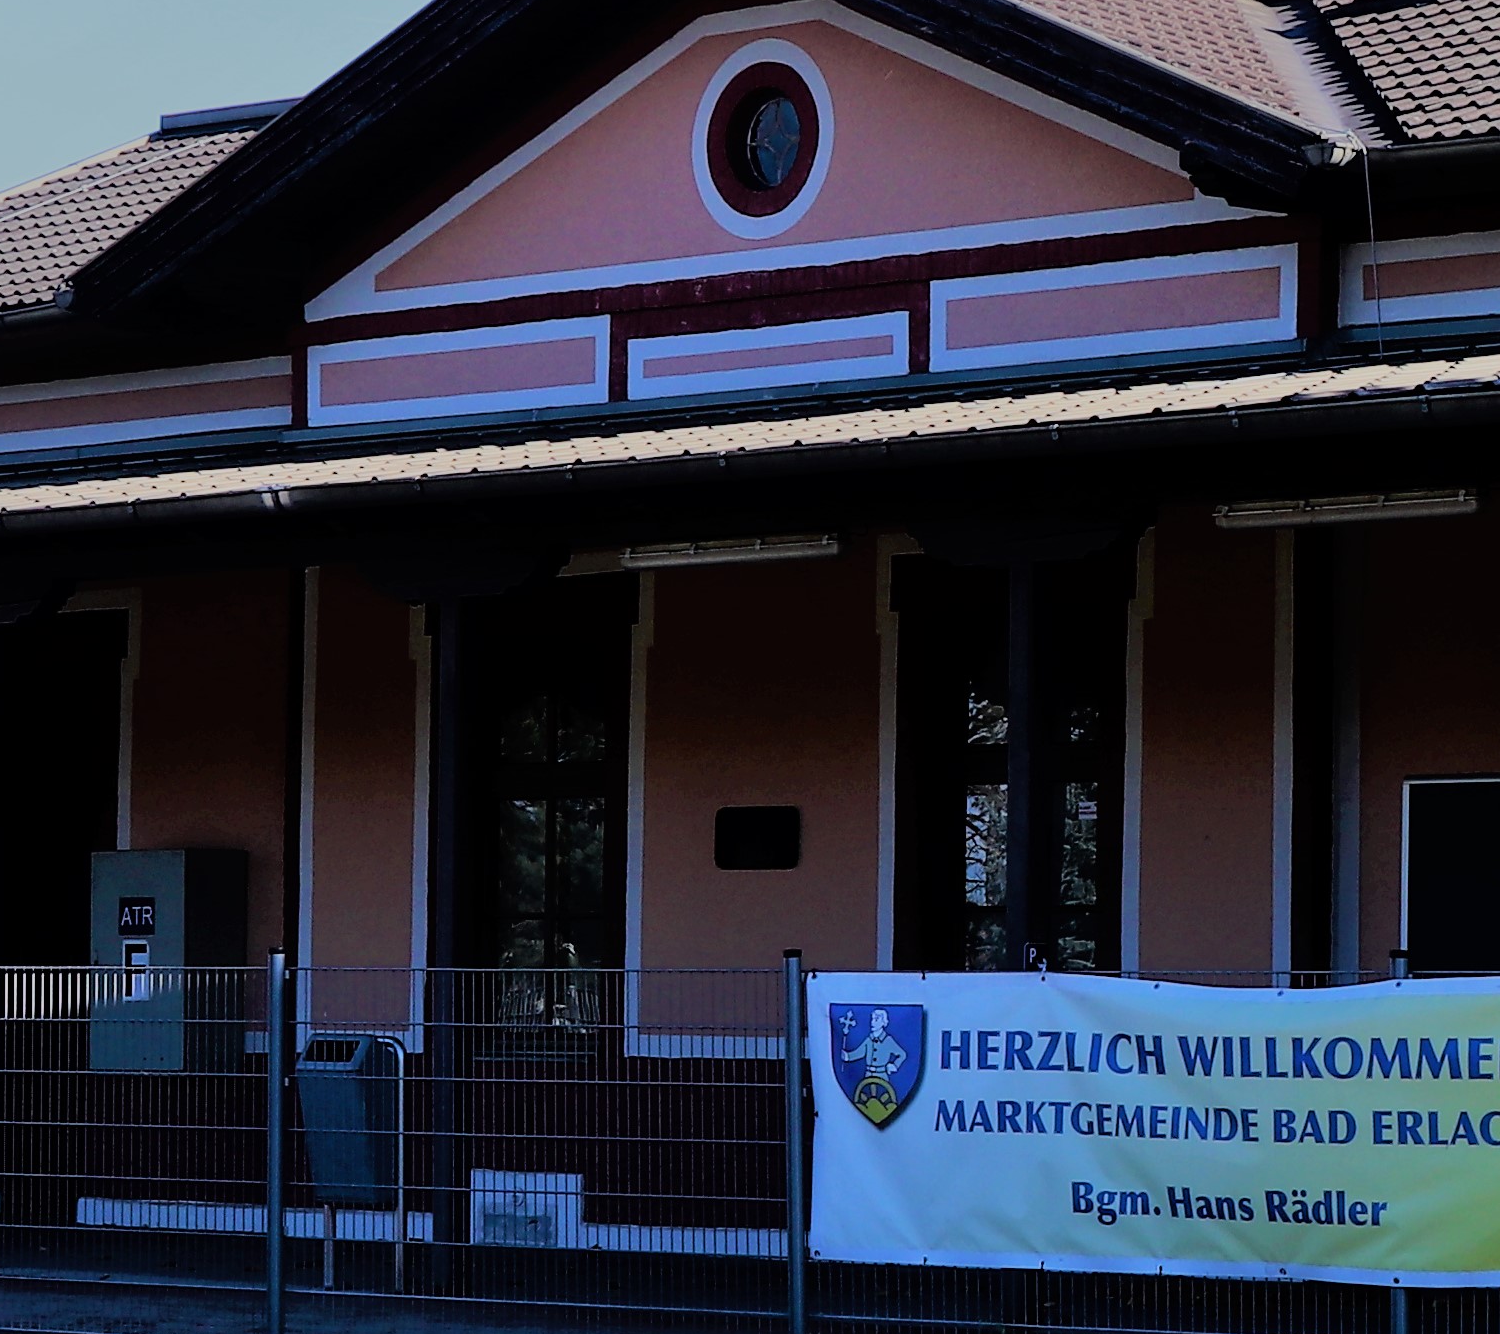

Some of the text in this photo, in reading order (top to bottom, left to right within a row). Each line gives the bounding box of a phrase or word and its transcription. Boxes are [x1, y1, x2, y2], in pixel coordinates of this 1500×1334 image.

[120, 906, 153, 926] ATR
[940, 1029, 1167, 1075] HERZLICH
[934, 1099, 1260, 1142] MARKTGEMEINDE
[1273, 1108, 1358, 1145] BAD
[1070, 1181, 1388, 1227] Bgm. Hans Rädler
